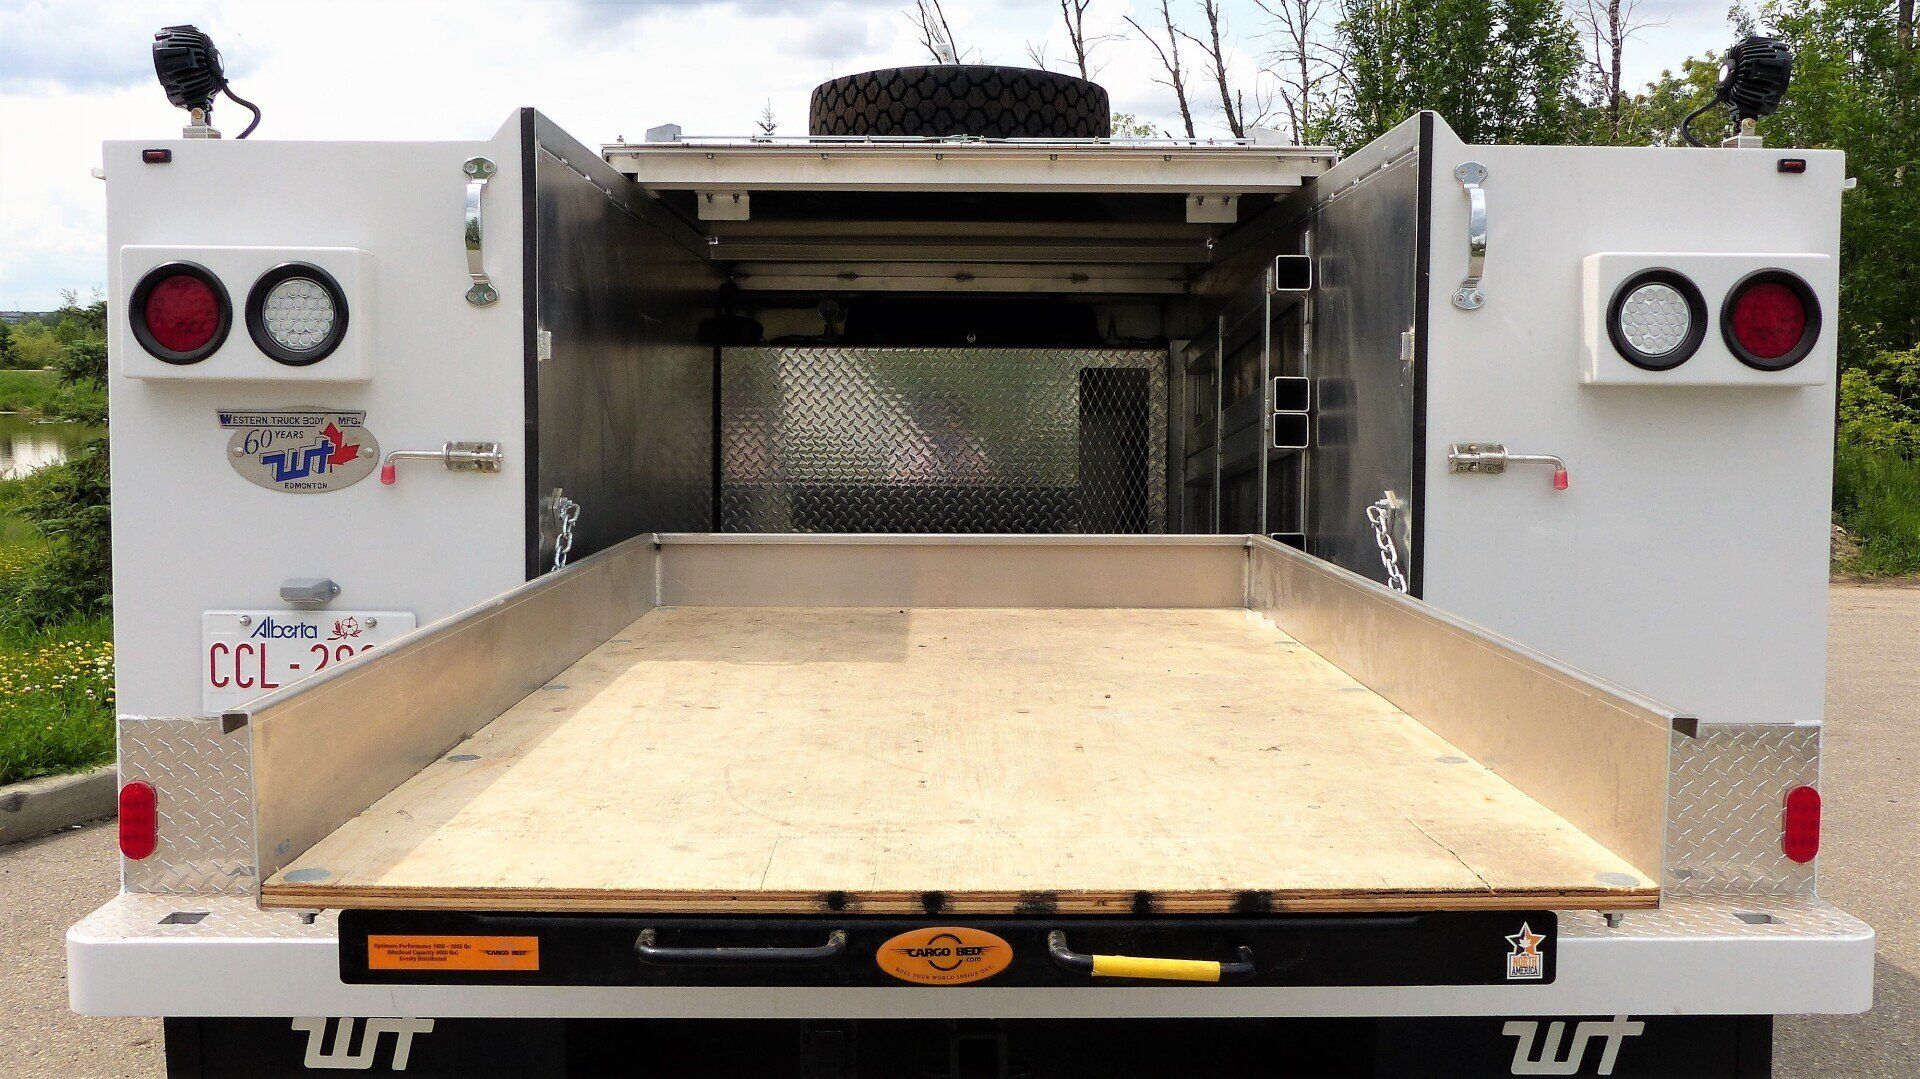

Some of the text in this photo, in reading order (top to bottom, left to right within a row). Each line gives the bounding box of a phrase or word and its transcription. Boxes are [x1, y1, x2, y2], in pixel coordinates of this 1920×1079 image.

[219, 414, 361, 425] WESTERN TRUCK BODY MFG.
[244, 429, 304, 455] 60 YEARS
[284, 482, 328, 490] EDMONTON
[250, 616, 318, 639] Alberta
[209, 642, 375, 689] CCL-2
[907, 947, 982, 957] CARGO BED
